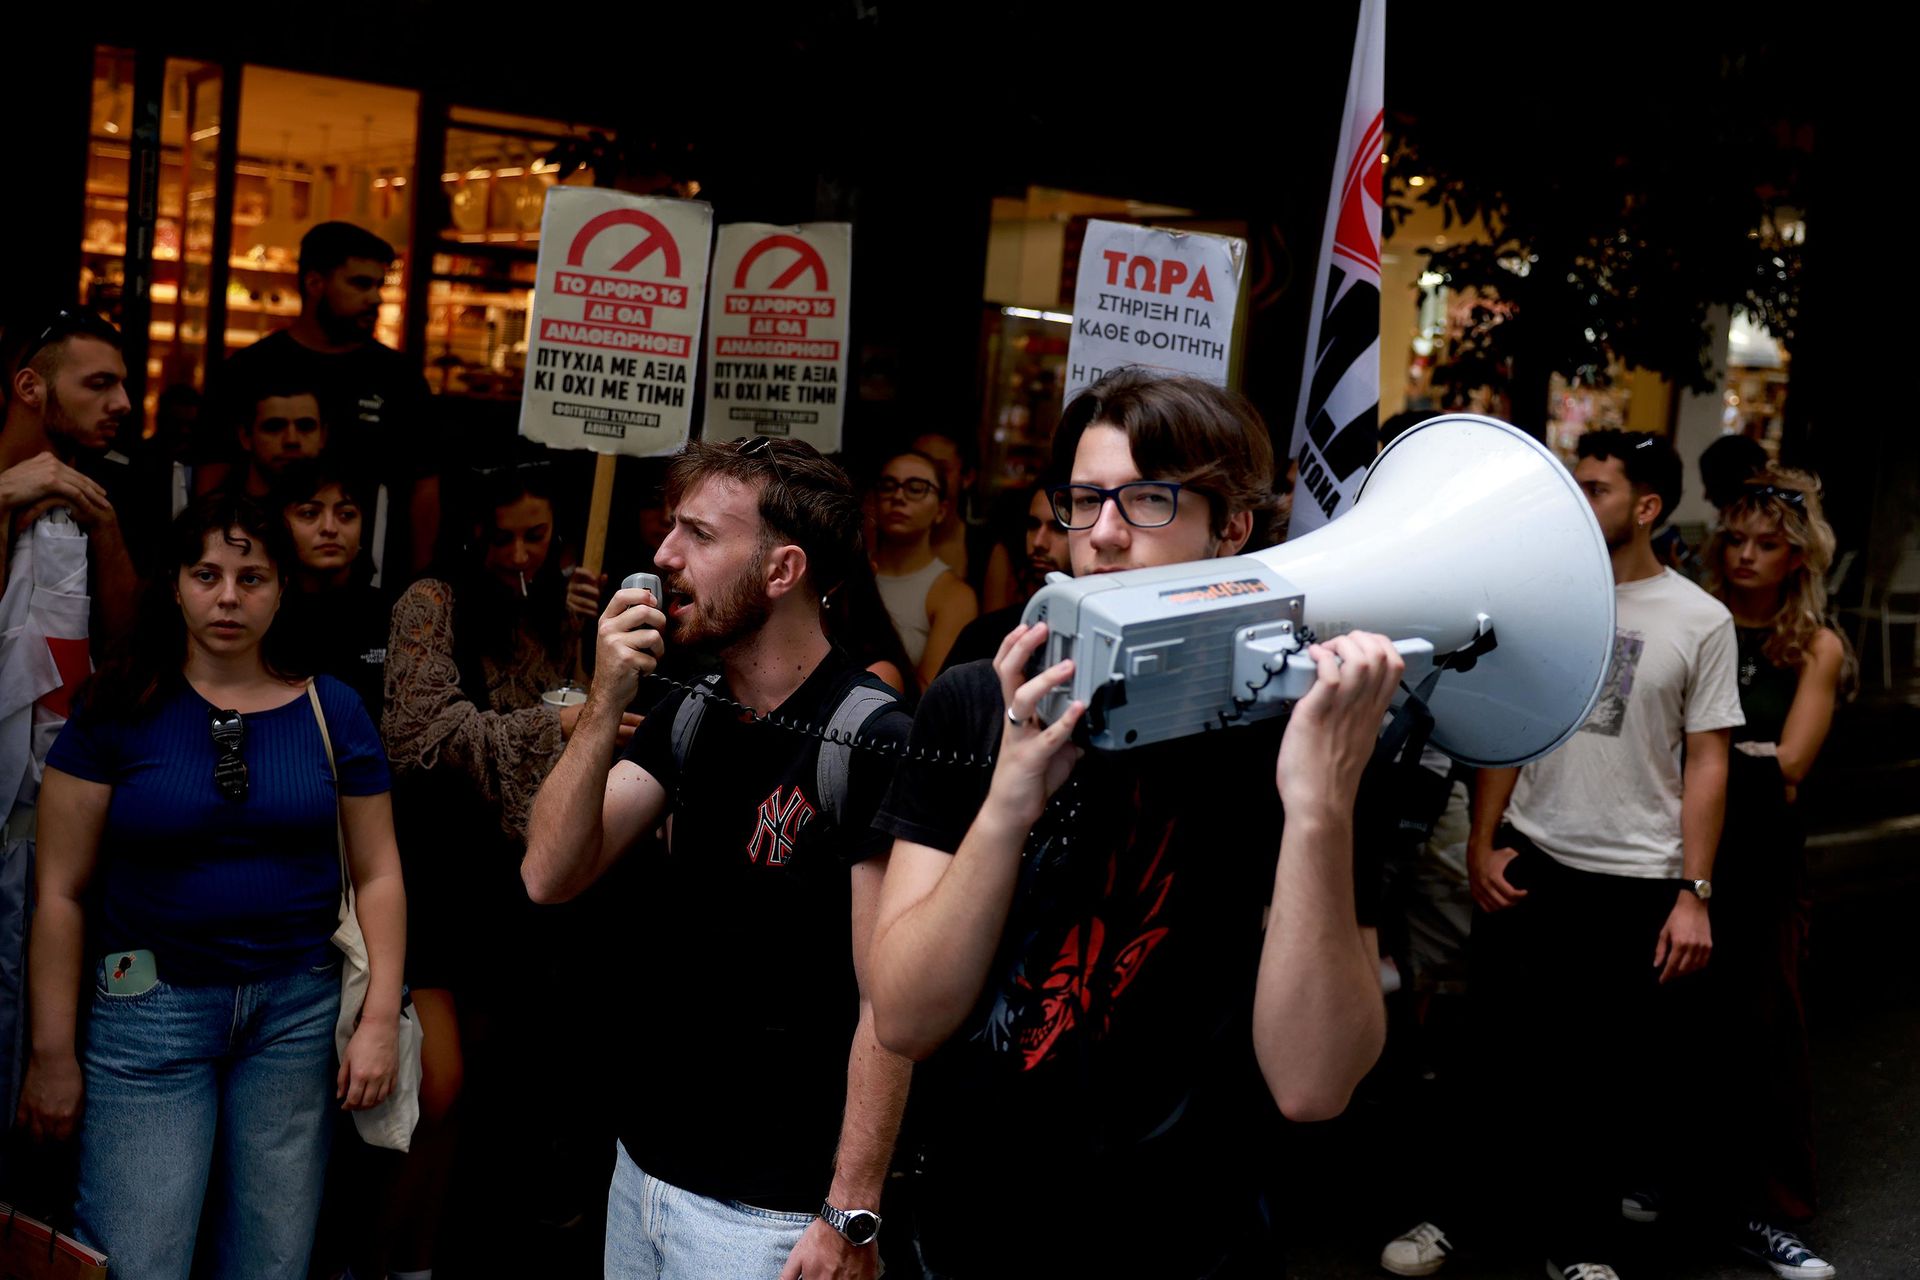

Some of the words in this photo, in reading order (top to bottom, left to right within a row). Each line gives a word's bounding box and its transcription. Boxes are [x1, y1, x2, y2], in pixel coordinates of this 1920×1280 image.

[559, 275, 586, 293] ΤΟ
[589, 279, 657, 302] ΑΡΘΡΟ
[661, 287, 682, 305] 16
[1103, 250, 1214, 303] ΤΩΡΑ
[589, 304, 615, 321] ΔΕ
[617, 307, 646, 325] ΘΑ
[729, 297, 750, 312] ΤΟ
[1097, 293, 1178, 323] ΣΤΗΡΙΞΗ
[1184, 308, 1211, 329] ΓΙΑ
[545, 323, 686, 354] ΑΝΑΘΕΩΡΗΘΕΙ
[1079, 318, 1130, 343] ΚΑΘΕ
[1134, 329, 1224, 361] ΦΟΙΤΗΤΗ
[537, 348, 604, 374] ΠΤΥΧΙΑ
[610, 357, 638, 377] ΜΕ
[643, 360, 686, 384] ΑΞΙΑ
[715, 362, 767, 379] ΠΤΥΧΙΑ
[773, 364, 796, 381] ΜΕ
[802, 366, 837, 383] ΑΞΙΑ
[534, 370, 555, 392] ΚΙ
[562, 373, 595, 396] ΟΧΙ
[601, 379, 630, 400] ΜΕ
[637, 383, 685, 407] ΤΙΜΗ
[714, 382, 730, 399] ΚΙ
[735, 383, 761, 400] ΟΧΙ
[766, 384, 790, 402] ΜΕ
[798, 385, 836, 404] ΤΙΜΗ
